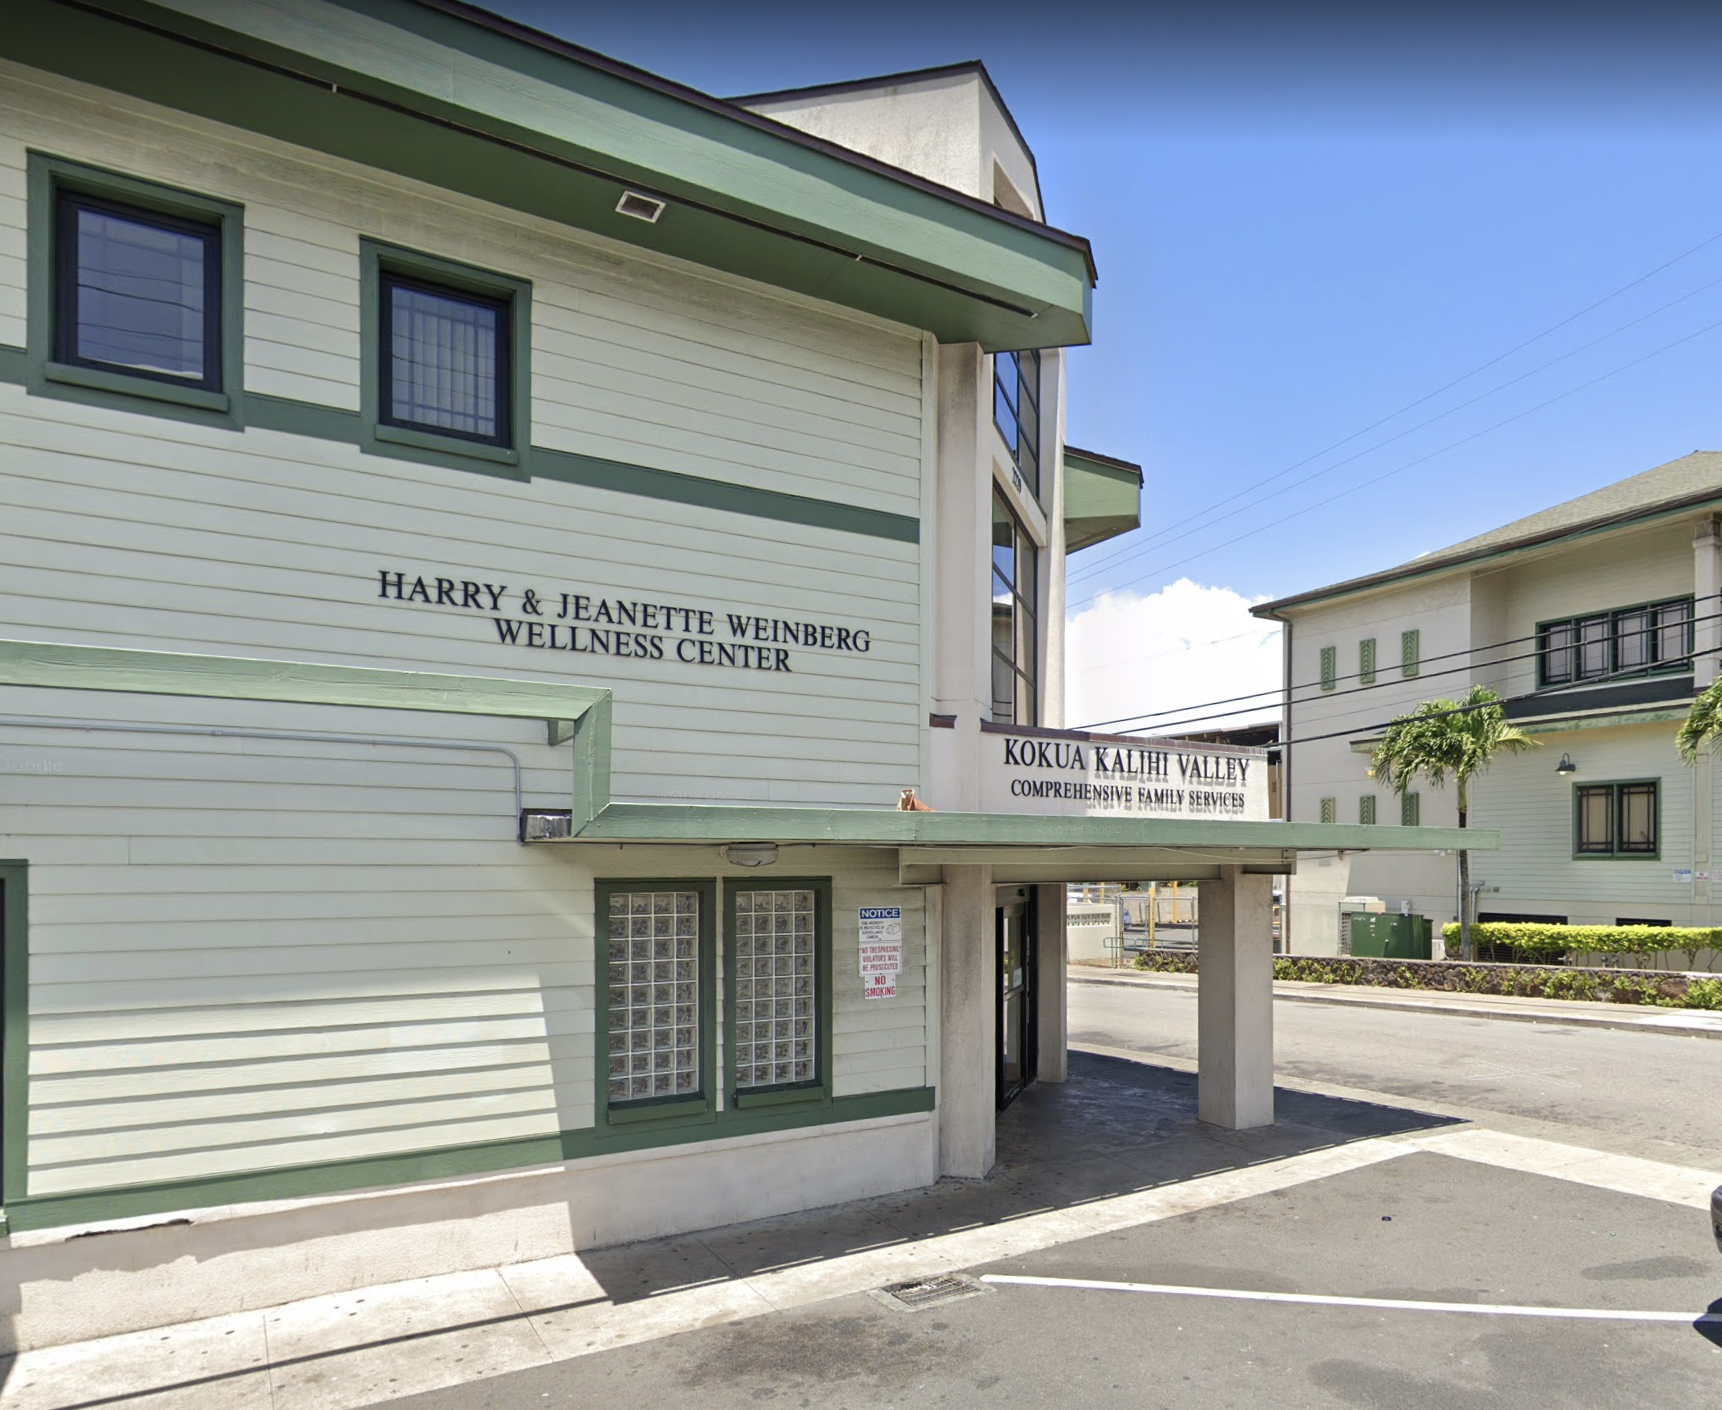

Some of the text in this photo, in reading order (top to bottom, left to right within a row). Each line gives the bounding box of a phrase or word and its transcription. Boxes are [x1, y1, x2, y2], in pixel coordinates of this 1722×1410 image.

[378, 570, 872, 653] HARRY & JEANETTE WEINBERG
[492, 617, 792, 672] WELLNESS CENTER
[1004, 738, 1250, 781] KOKUA KALIHI VALLEY
[1011, 779, 1245, 808] COMPREHENSIVE FAMILY SERVICES
[861, 909, 899, 918] NOTICE
[870, 963, 898, 971] PROSECUTED
[875, 976, 886, 985] NO
[866, 986, 895, 997] SMOKING
